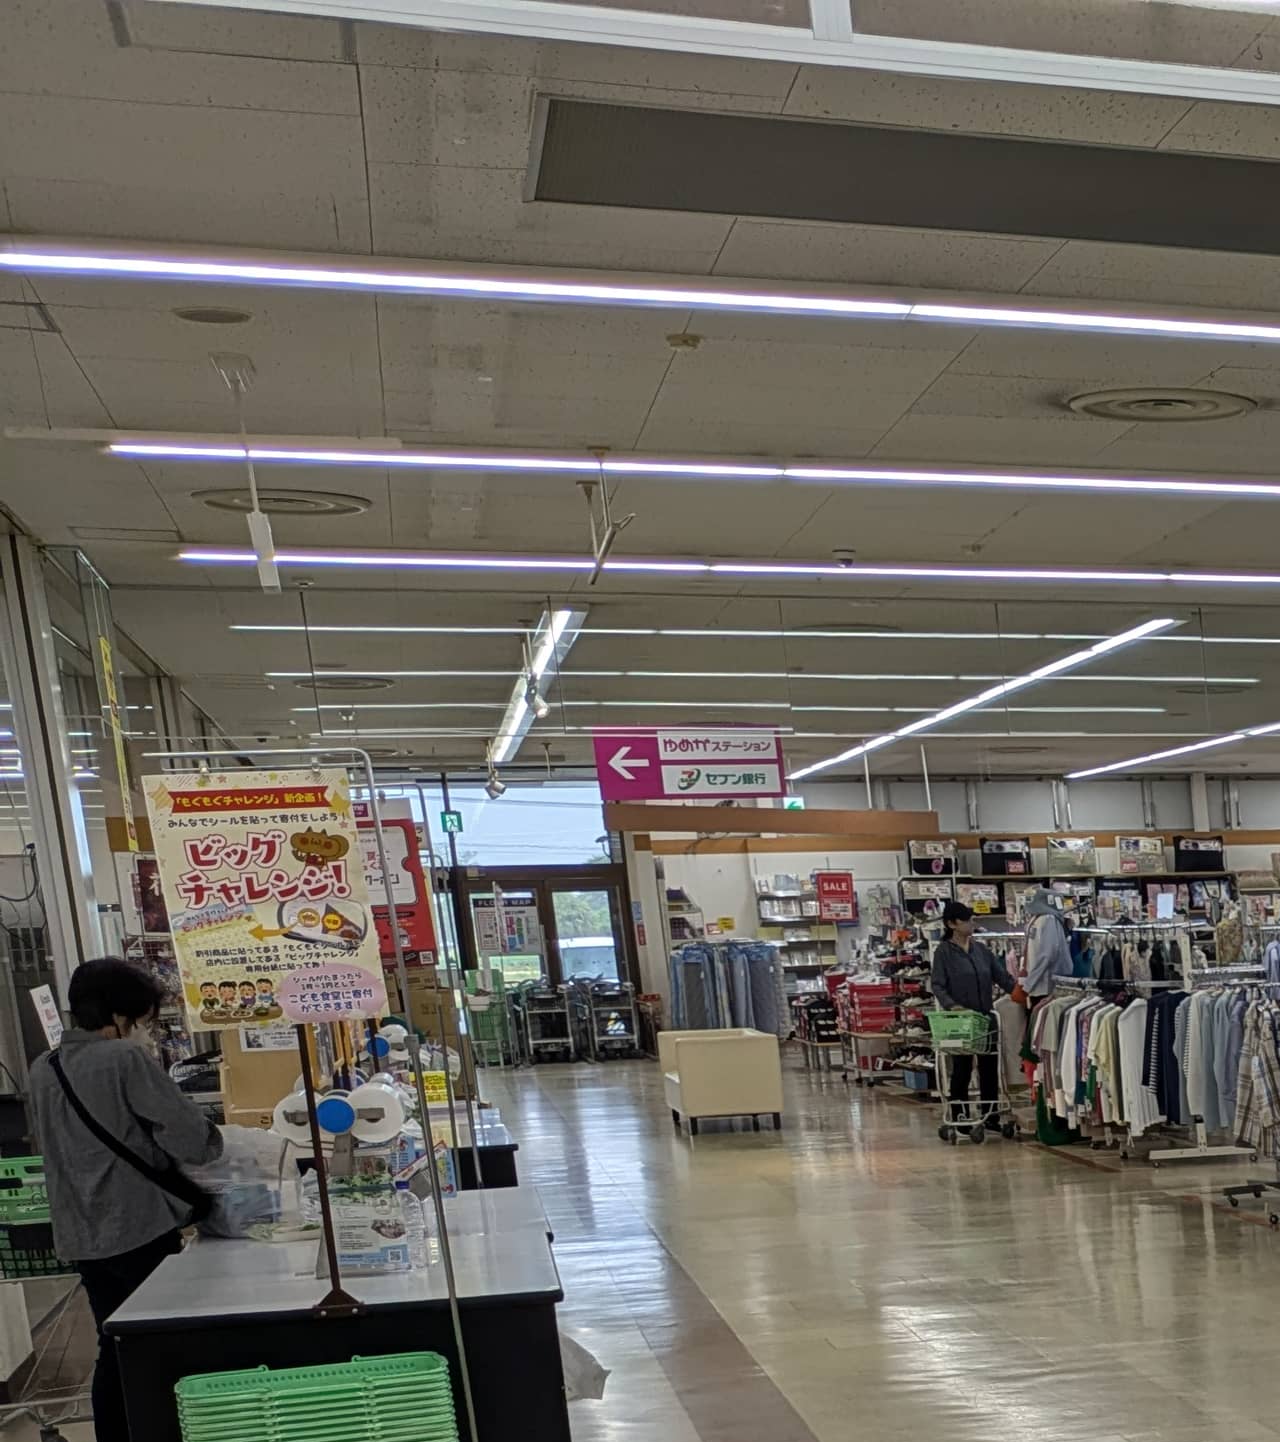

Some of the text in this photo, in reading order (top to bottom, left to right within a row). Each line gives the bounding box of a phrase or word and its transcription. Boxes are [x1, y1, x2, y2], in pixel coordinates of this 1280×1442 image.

[705, 773, 766, 786] セブン銀行
[184, 829, 288, 871] ビッグ
[823, 882, 848, 891] SALE
[289, 989, 373, 1004] こども食堂に寄付
